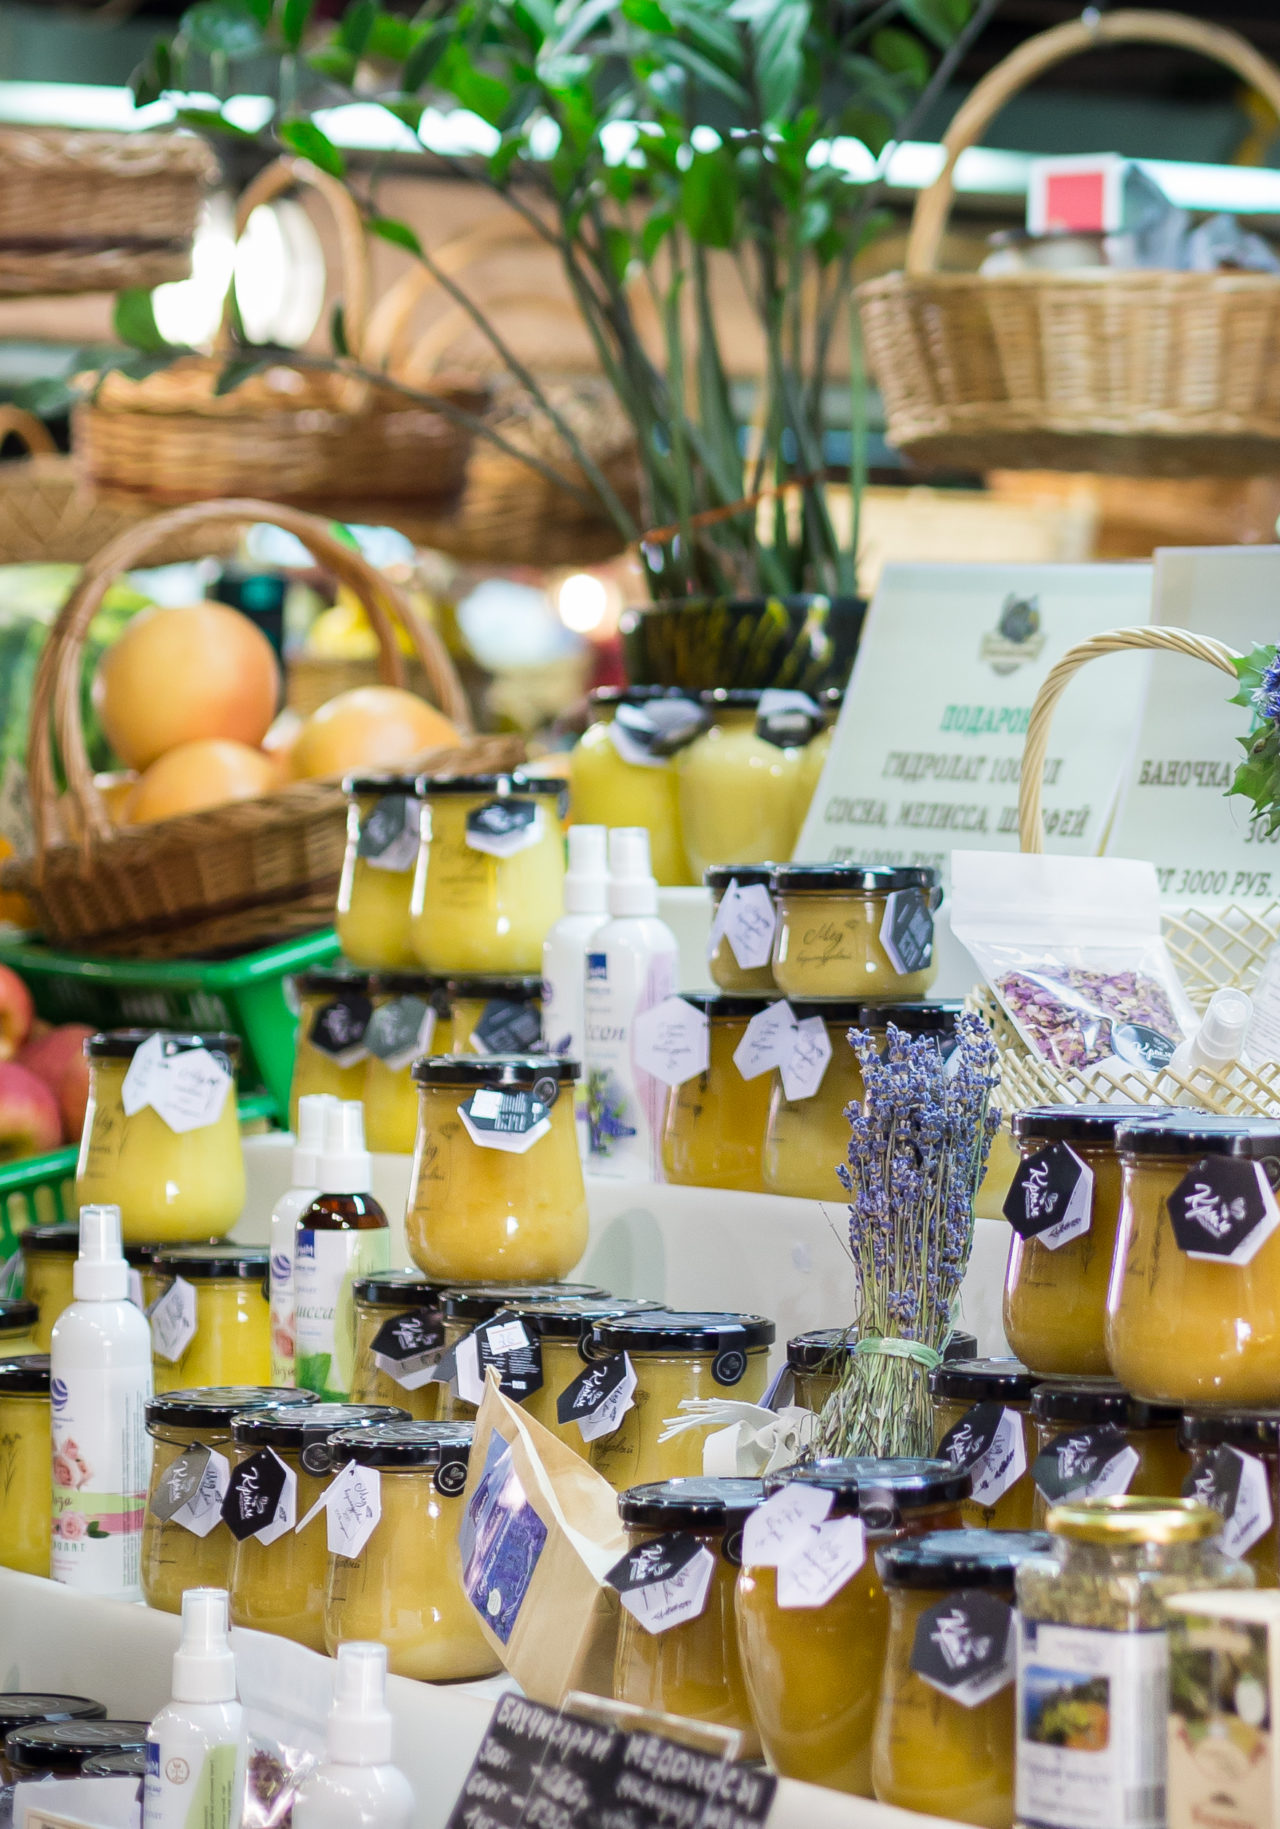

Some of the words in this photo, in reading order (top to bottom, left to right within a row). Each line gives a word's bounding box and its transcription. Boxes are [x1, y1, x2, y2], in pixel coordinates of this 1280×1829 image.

[882, 750, 987, 783] ГИДРОЛАТ
[1138, 759, 1234, 788] БАНОЧКА
[997, 803, 1091, 838] ШФЕЙ
[1177, 869, 1228, 896] 3000
[1231, 871, 1273, 898] РУБ.
